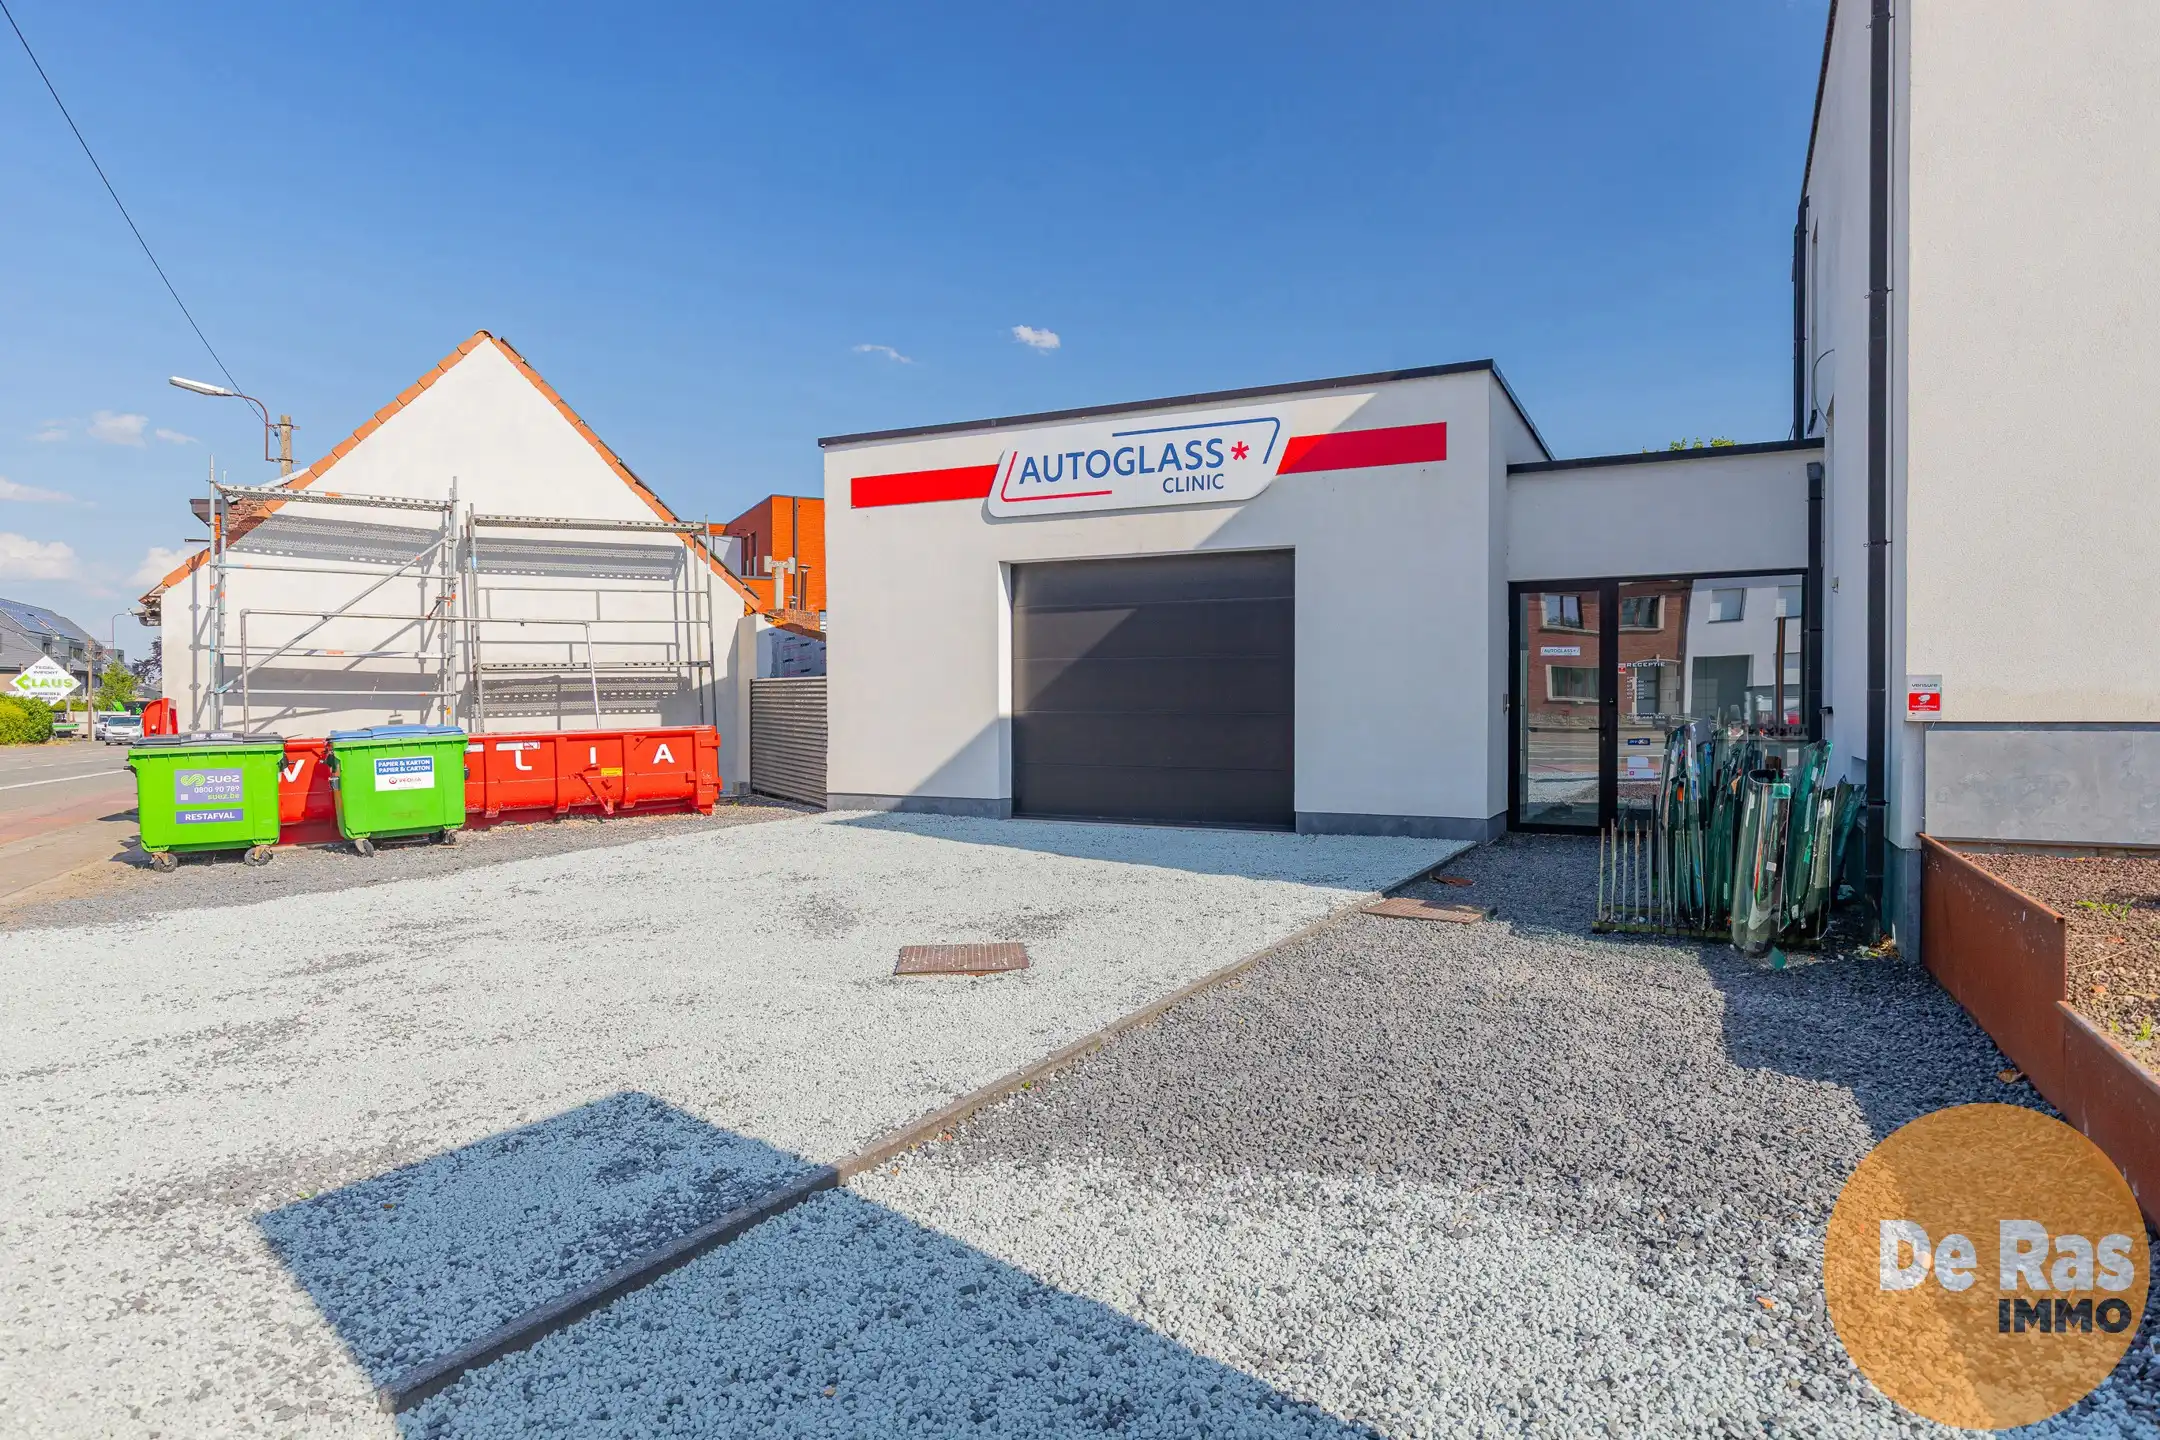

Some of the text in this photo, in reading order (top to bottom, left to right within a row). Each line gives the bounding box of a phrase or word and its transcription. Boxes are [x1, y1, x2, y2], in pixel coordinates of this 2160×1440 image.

[1018, 438, 1225, 485] AUTOGLASS
[1162, 473, 1224, 494] CLINIC
[185, 811, 236, 821] RESTAFVAL
